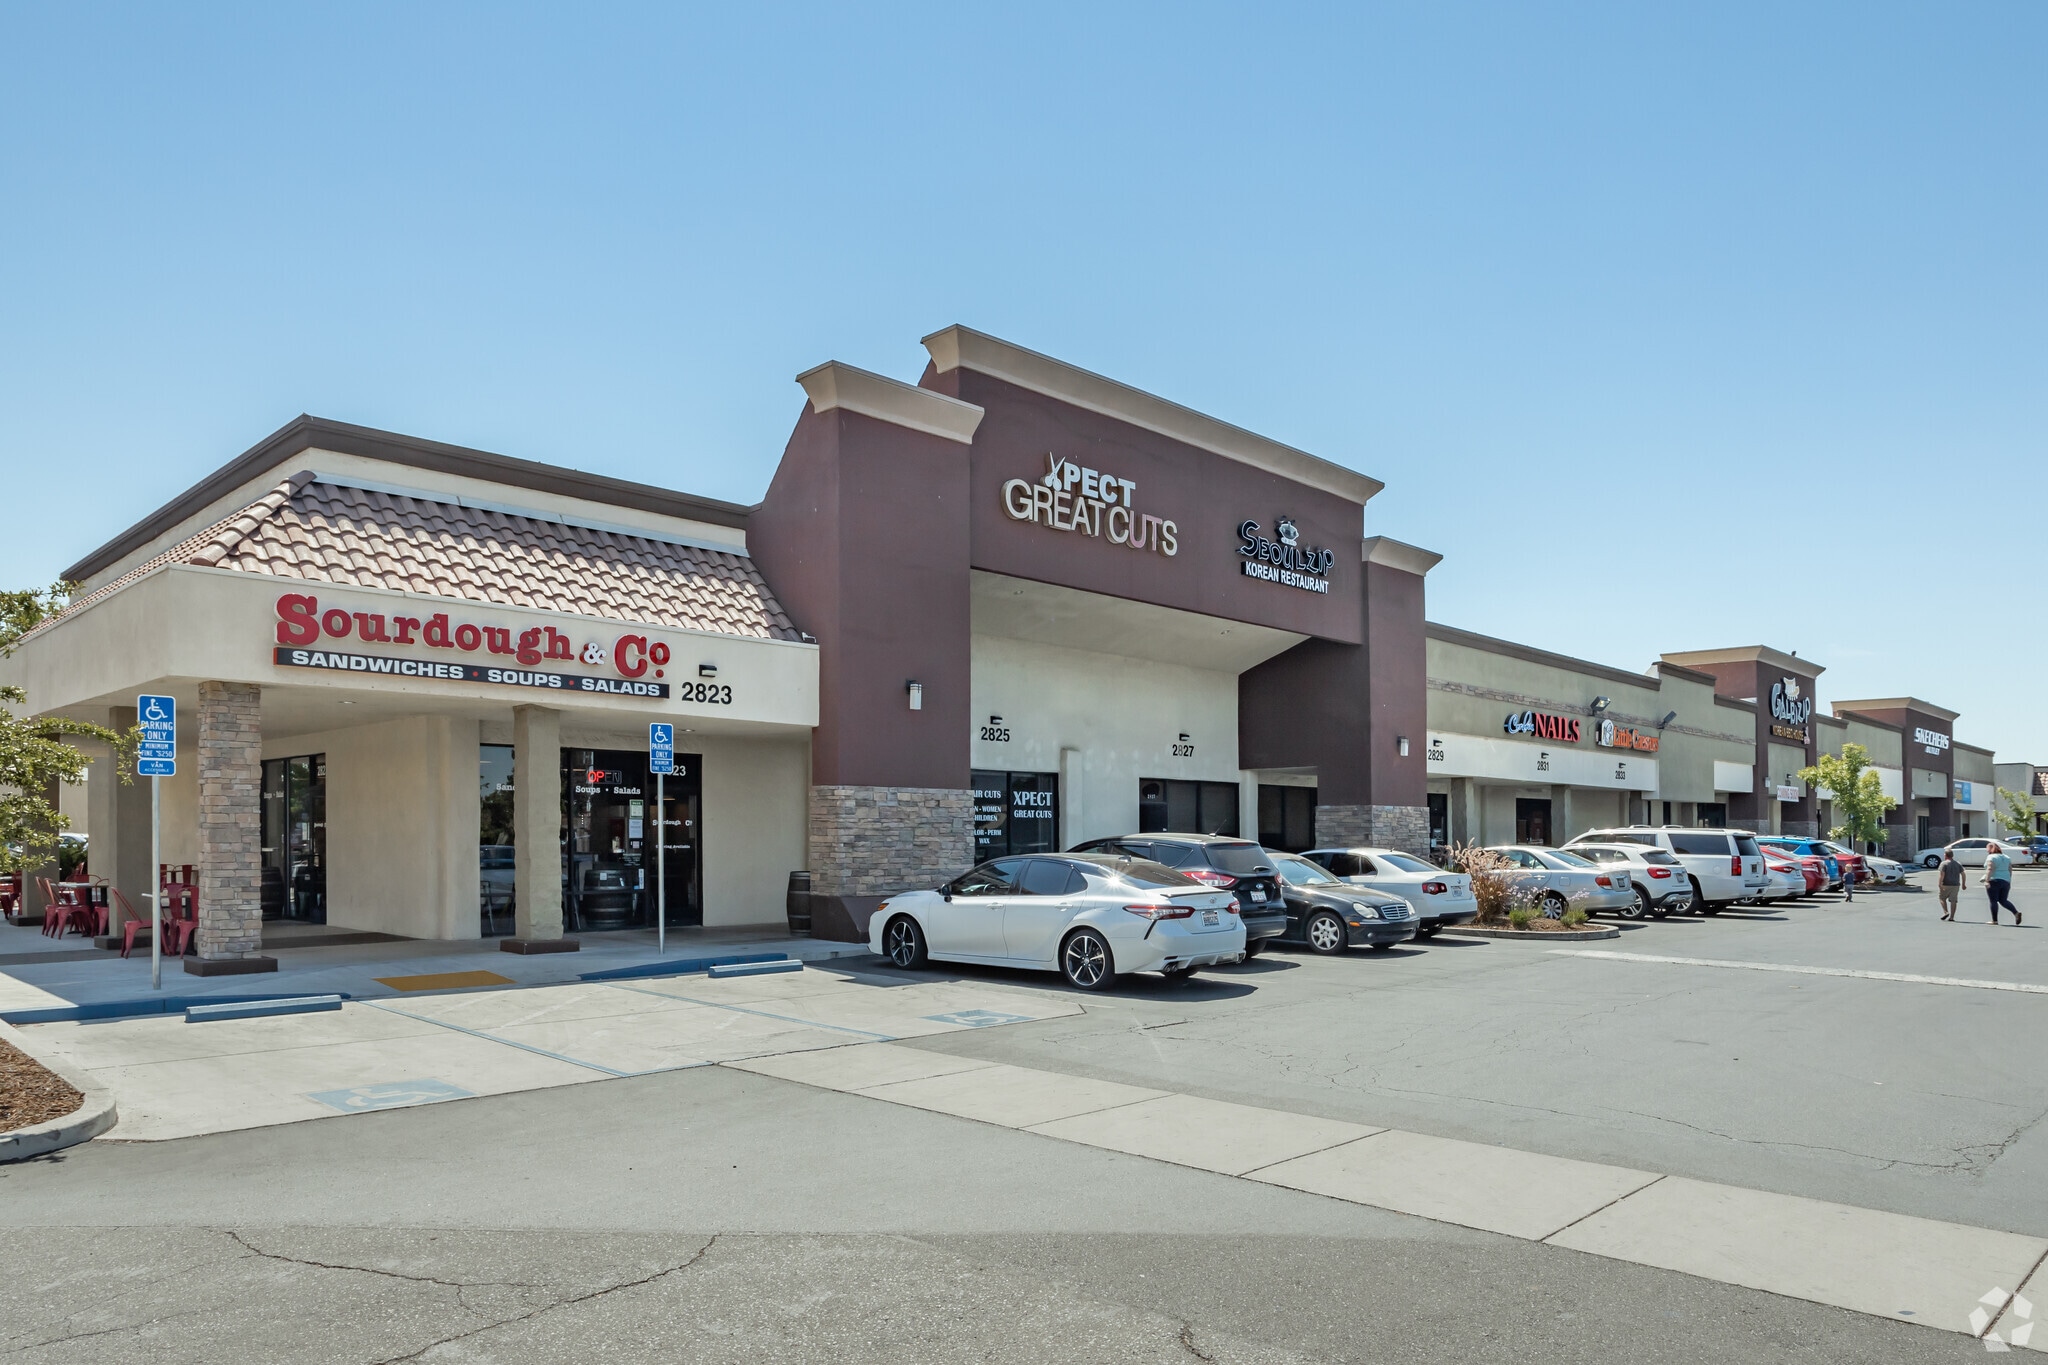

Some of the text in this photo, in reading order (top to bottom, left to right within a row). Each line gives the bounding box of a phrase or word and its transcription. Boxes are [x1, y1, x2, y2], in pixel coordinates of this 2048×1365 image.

[1002, 478, 1178, 556] GREAT CUTS
[1245, 561, 1329, 594] KOREAN RESTAURANT
[276, 593, 574, 666] Sourdough
[579, 642, 607, 665] &
[292, 650, 660, 696] SANDWICHES SOUPS SALADS
[681, 681, 733, 705] 2823
[141, 721, 173, 731] PARKING
[1535, 712, 1580, 743] NAILS
[147, 730, 167, 740] ONLY
[980, 726, 1010, 742] 2825
[1914, 727, 1949, 750] SKECHERS
[651, 742, 672, 751] PARKING
[1172, 744, 1194, 758] 2827
[1428, 749, 1444, 762] 2829
[1537, 761, 1549, 772] 2831
[587, 771, 621, 783] OPEN
[575, 785, 641, 795] Soups Salads
[984, 790, 1001, 799] CUTS
[1013, 791, 1053, 806] XPECT
[982, 805, 1002, 813] WOMEN
[1013, 809, 1052, 818] GREAT CUTS
